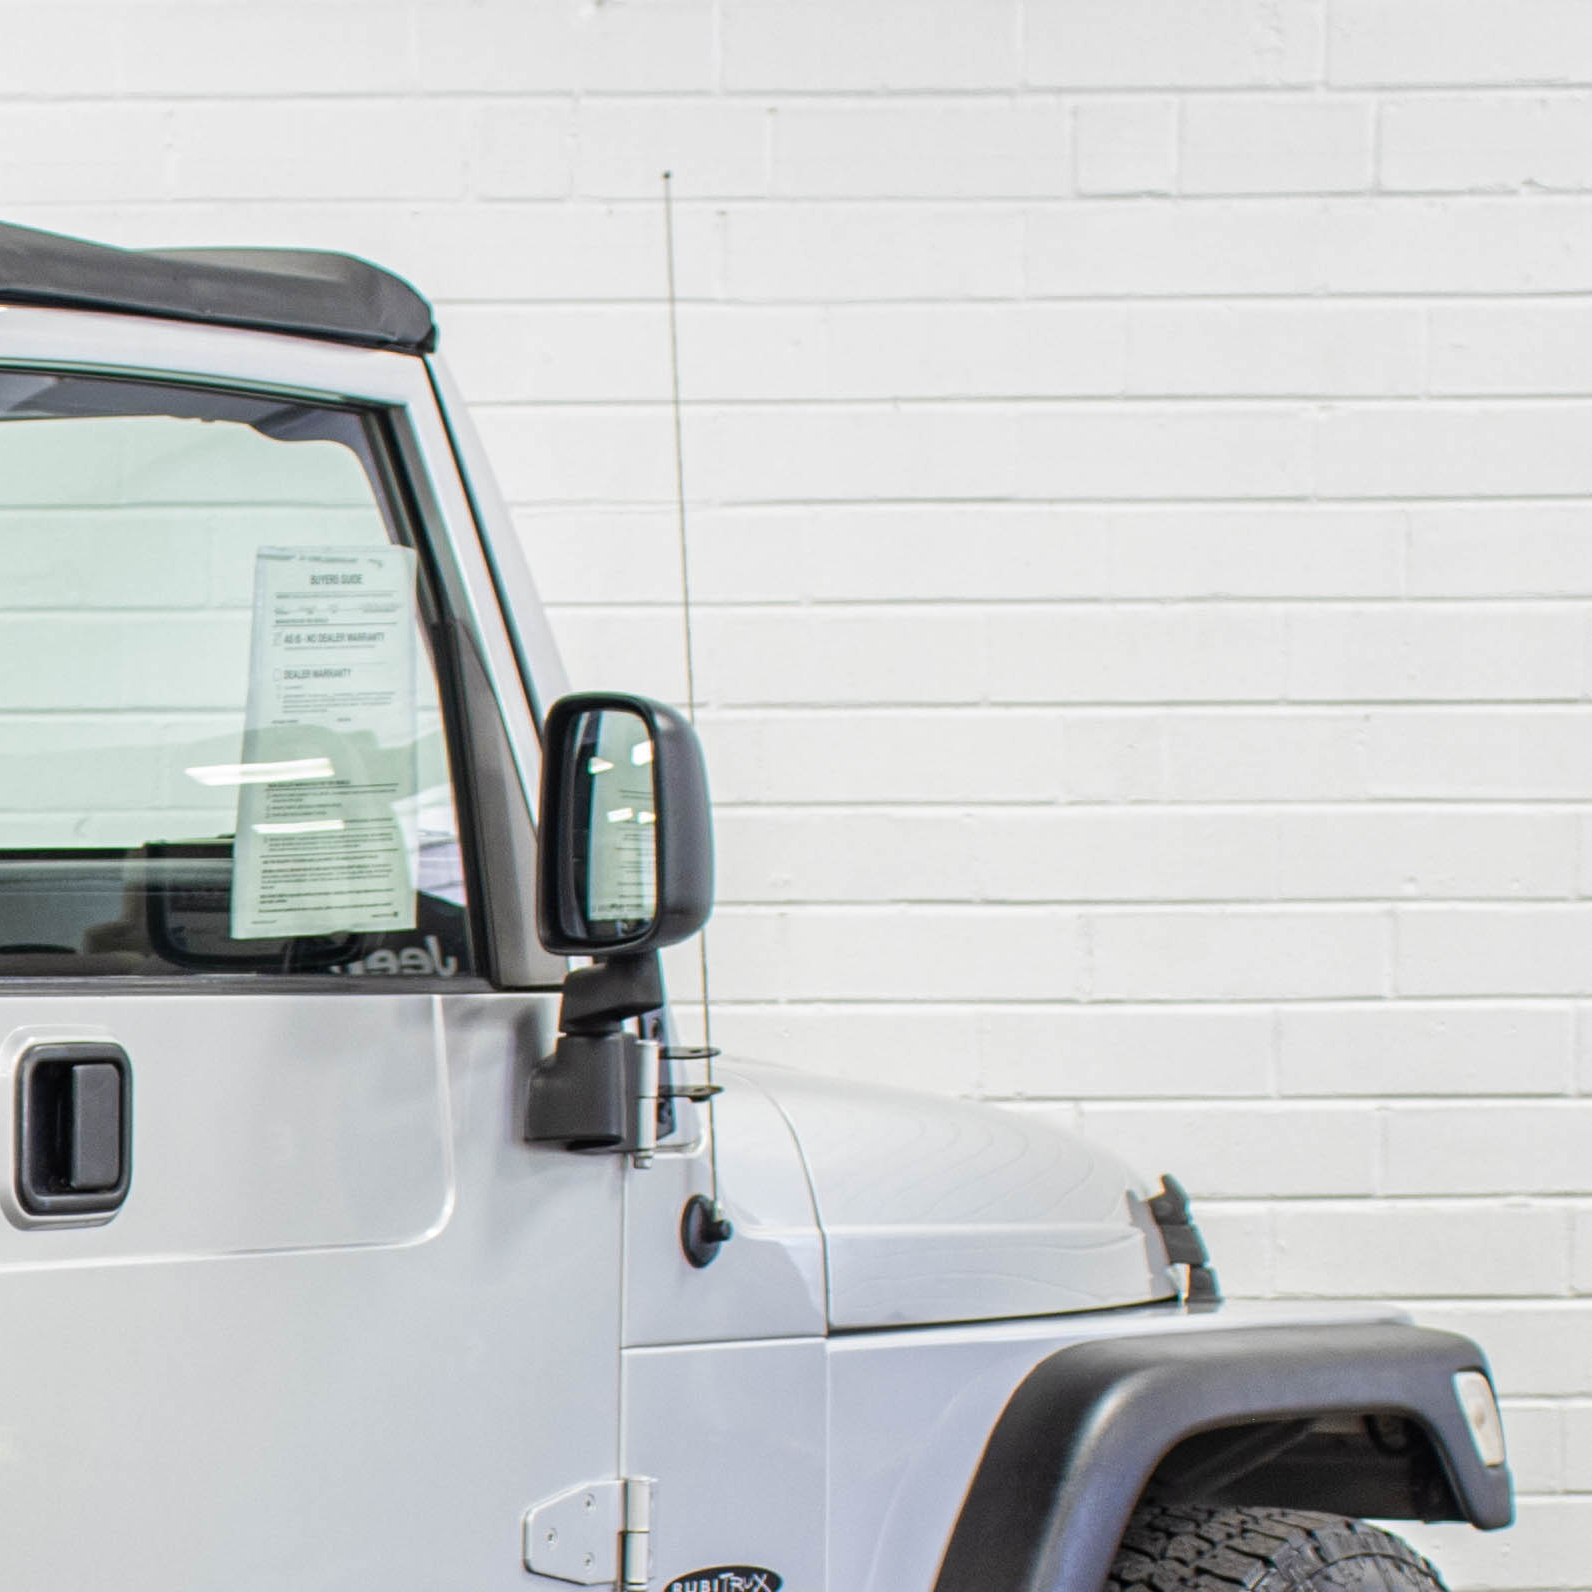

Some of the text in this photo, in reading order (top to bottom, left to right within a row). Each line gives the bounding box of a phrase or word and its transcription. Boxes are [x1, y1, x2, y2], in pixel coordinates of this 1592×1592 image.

[310, 573, 363, 586] BUYERS GUIDE
[347, 631, 385, 643] WARRANTY
[283, 668, 351, 681] DEALER WARRANTY
